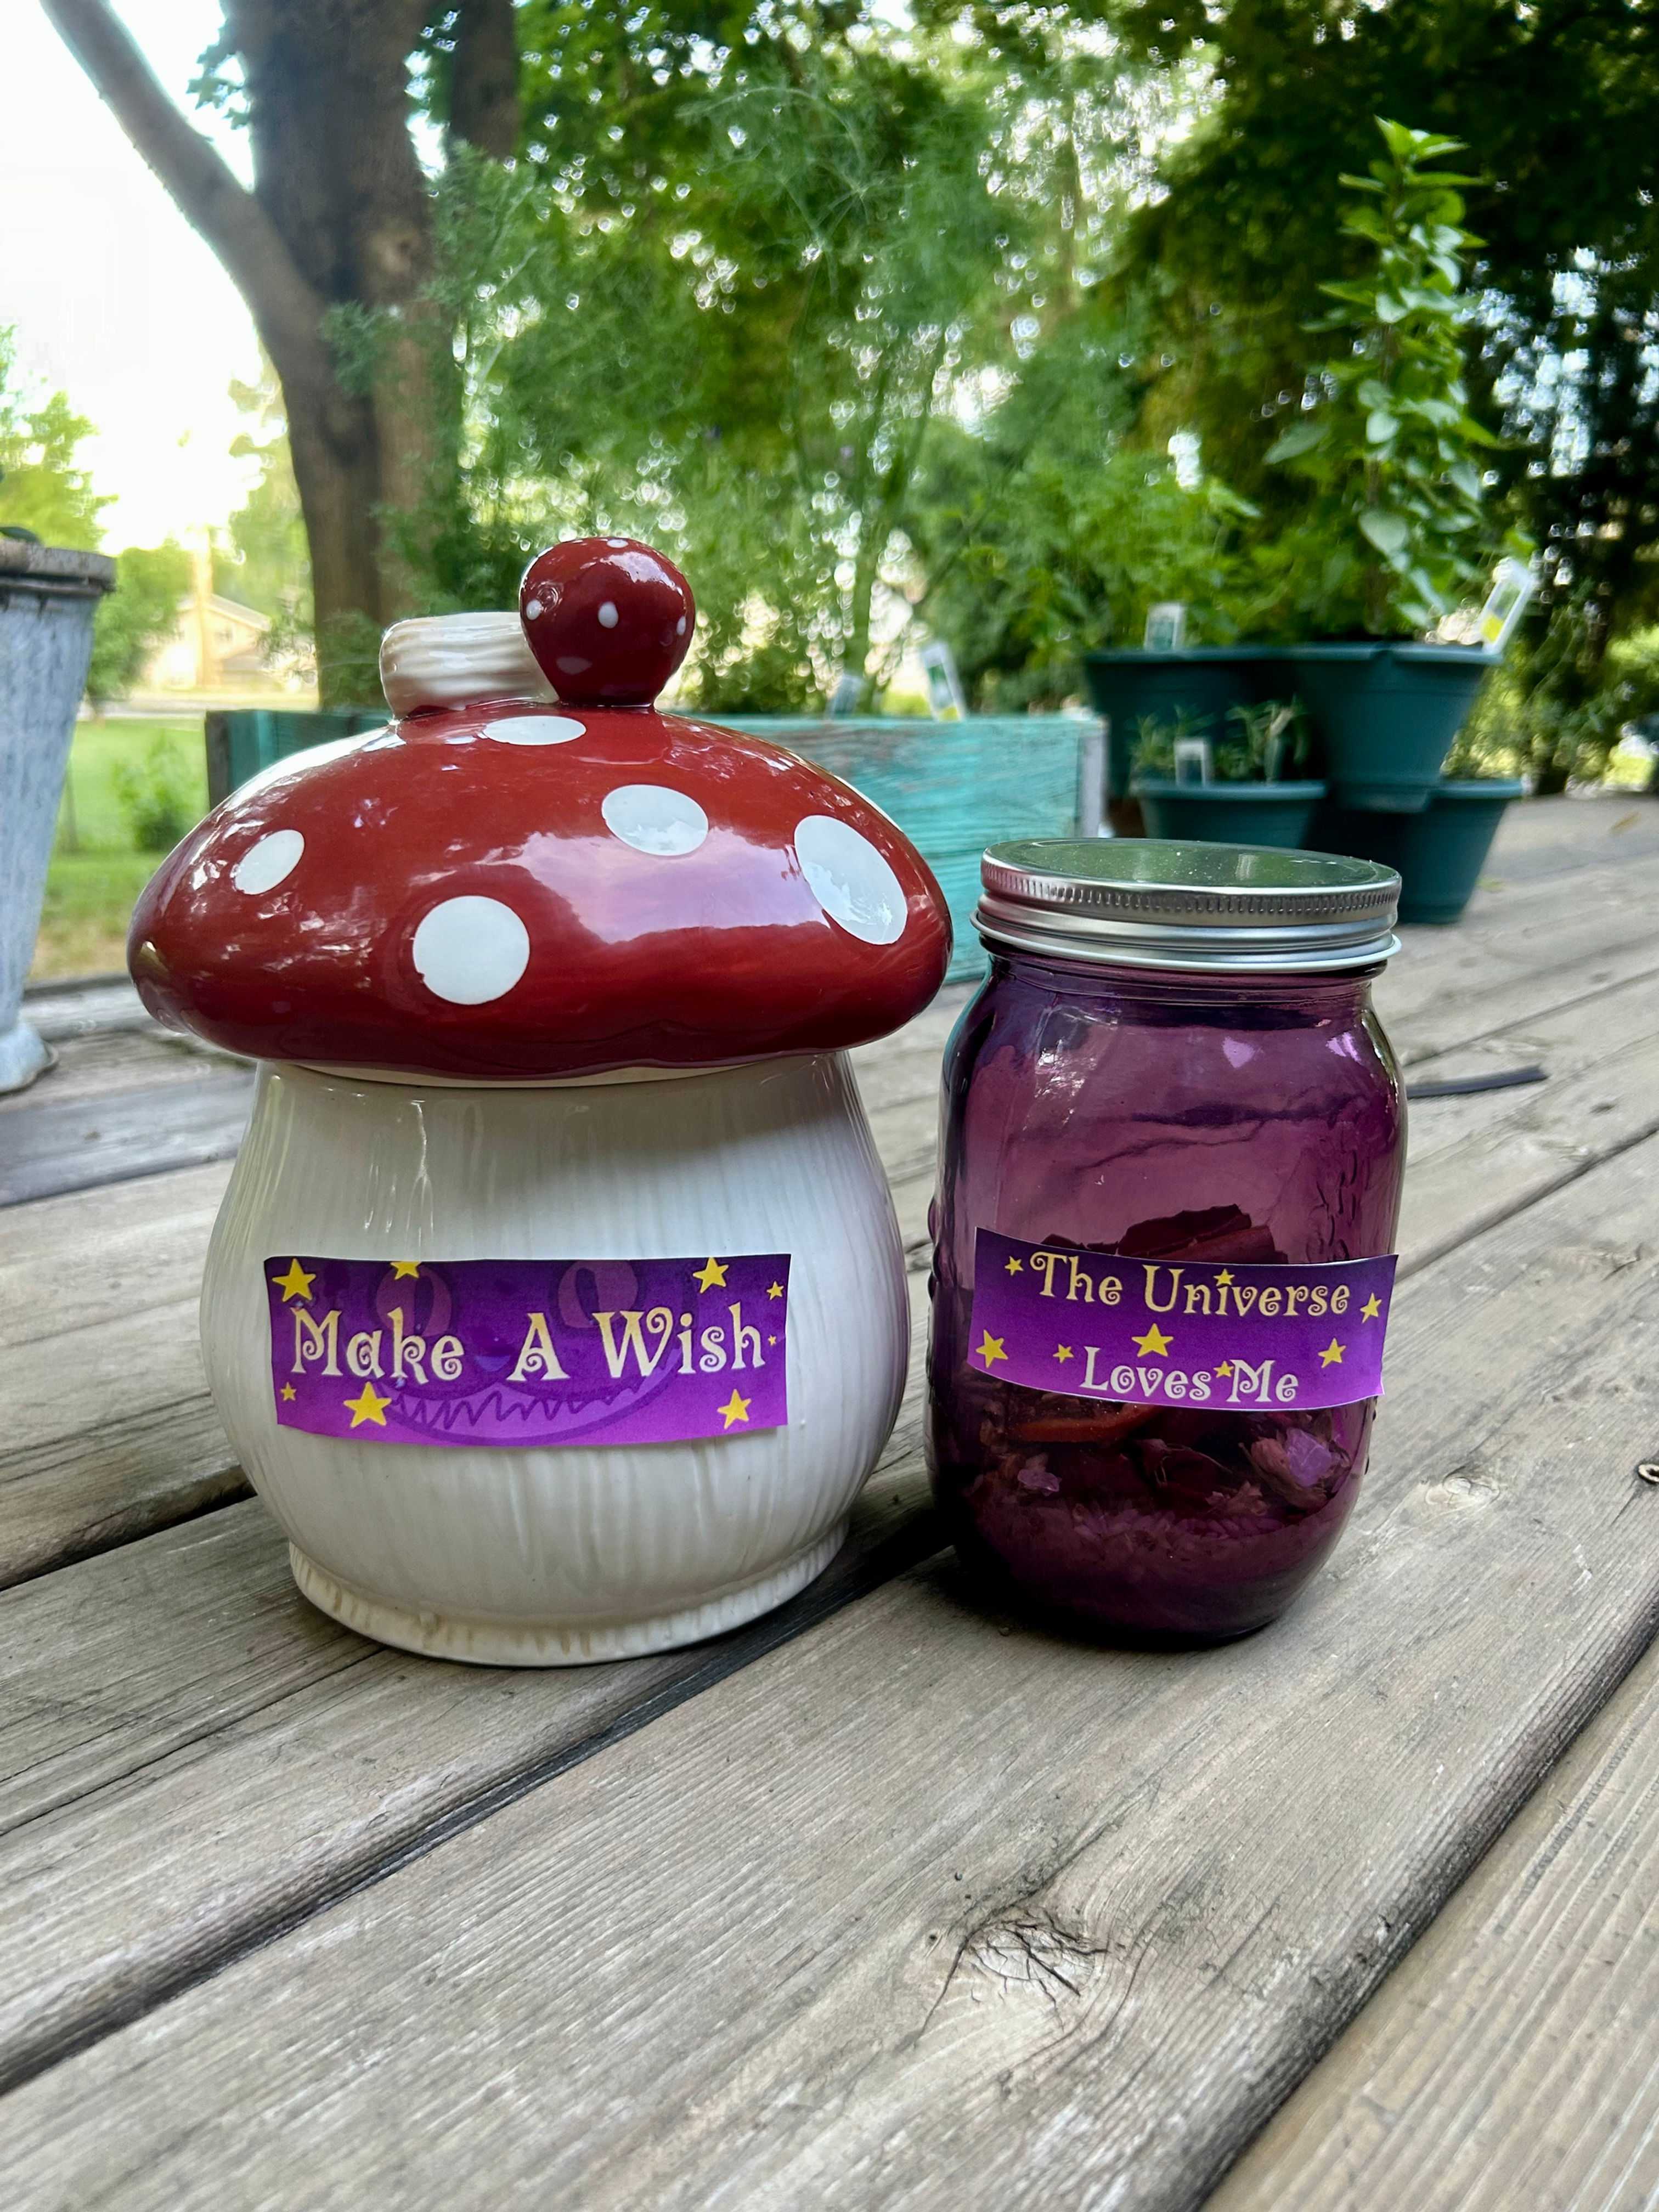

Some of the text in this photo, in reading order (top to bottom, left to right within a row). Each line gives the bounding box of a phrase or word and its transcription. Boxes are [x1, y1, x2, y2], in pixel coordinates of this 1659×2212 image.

[1029, 1251, 1350, 1316] The Universe
[290, 1302, 766, 1384] Make A Wish
[1079, 1346, 1299, 1402] Loves Me
